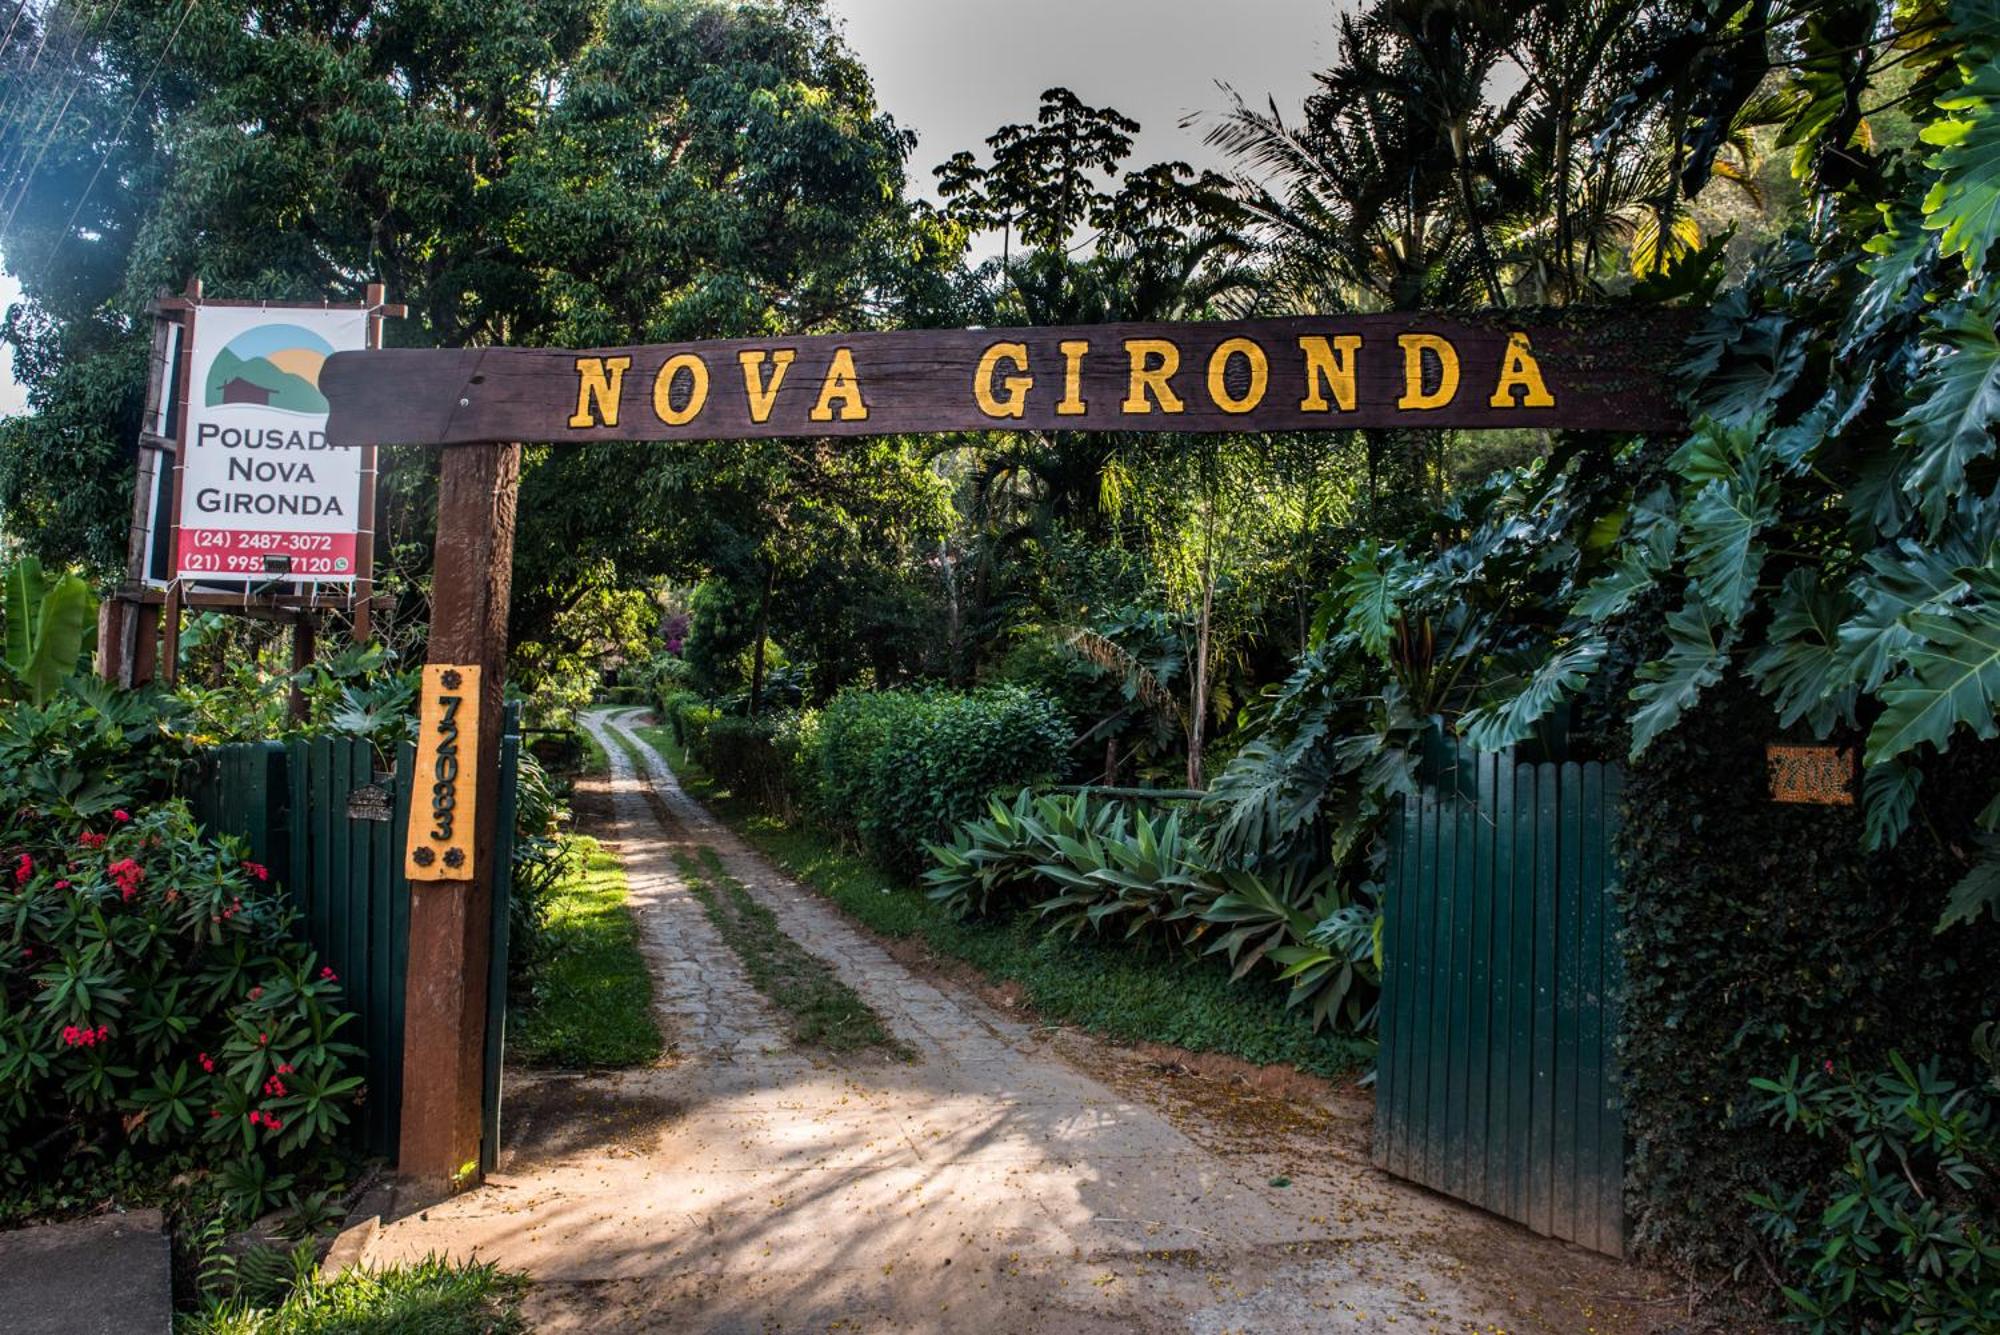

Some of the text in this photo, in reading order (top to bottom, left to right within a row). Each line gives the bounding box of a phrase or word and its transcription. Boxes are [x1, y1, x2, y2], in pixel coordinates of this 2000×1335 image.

[568, 332, 1556, 429] NOVA GIRONDA
[197, 423, 350, 452] POUSAD
[228, 456, 316, 484] NOVA
[196, 488, 344, 517] GIRONDA
[193, 531, 332, 550] (24) 2487-3072
[184, 553, 220, 570] (21)
[430, 696, 462, 841] 72083
